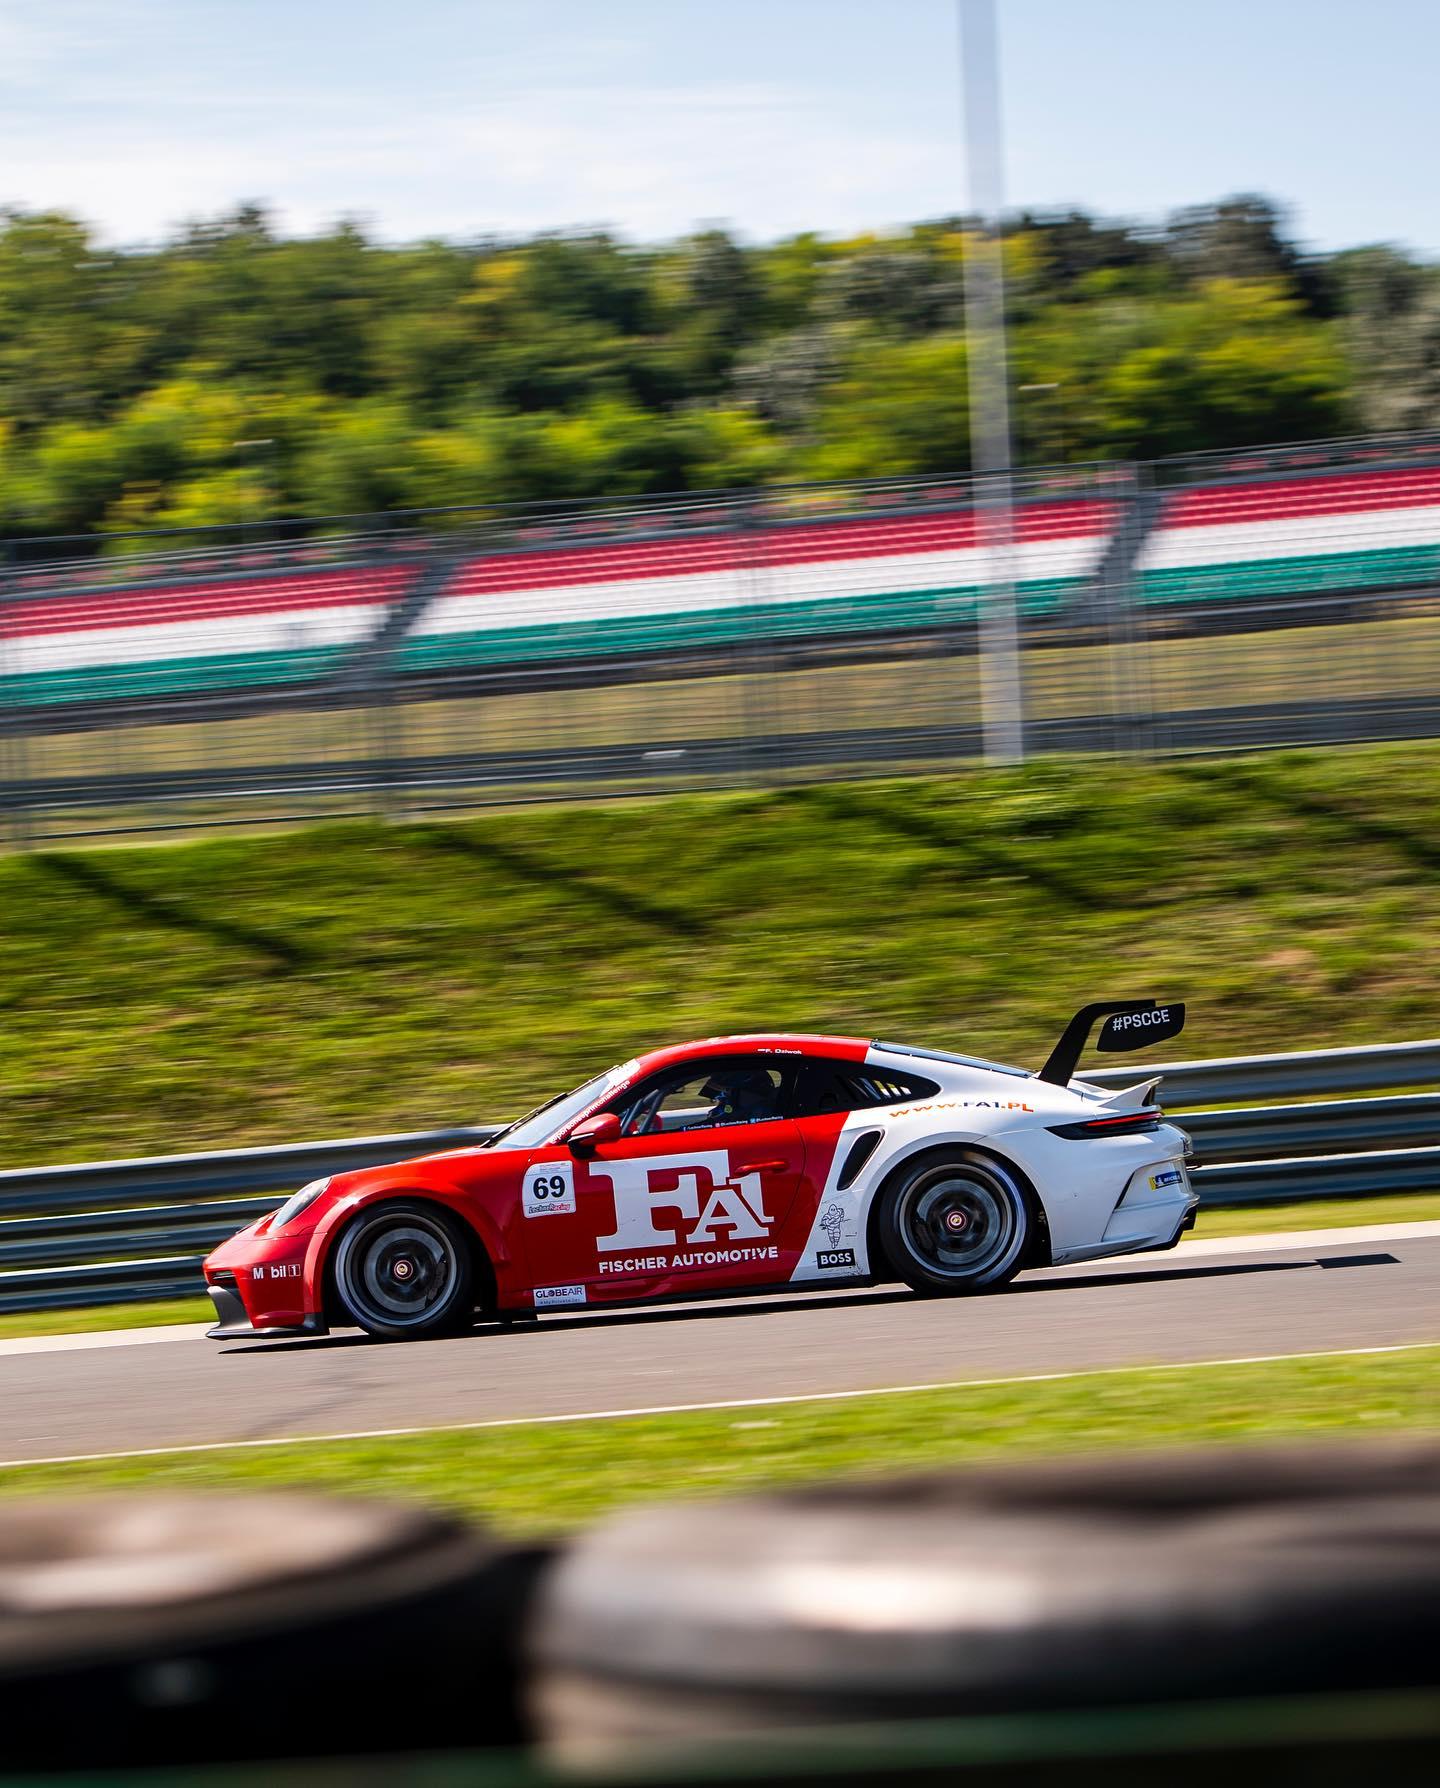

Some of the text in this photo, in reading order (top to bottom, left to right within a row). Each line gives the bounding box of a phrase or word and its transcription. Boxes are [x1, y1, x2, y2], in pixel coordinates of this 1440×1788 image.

[1113, 1009, 1170, 1031] #PSCCE
[533, 1175, 565, 1199] 69
[598, 1246, 779, 1273] FISCHER AUTOMOTIVE
[820, 1252, 852, 1265] BOSS
[535, 1286, 583, 1298] GLOBEAIR
